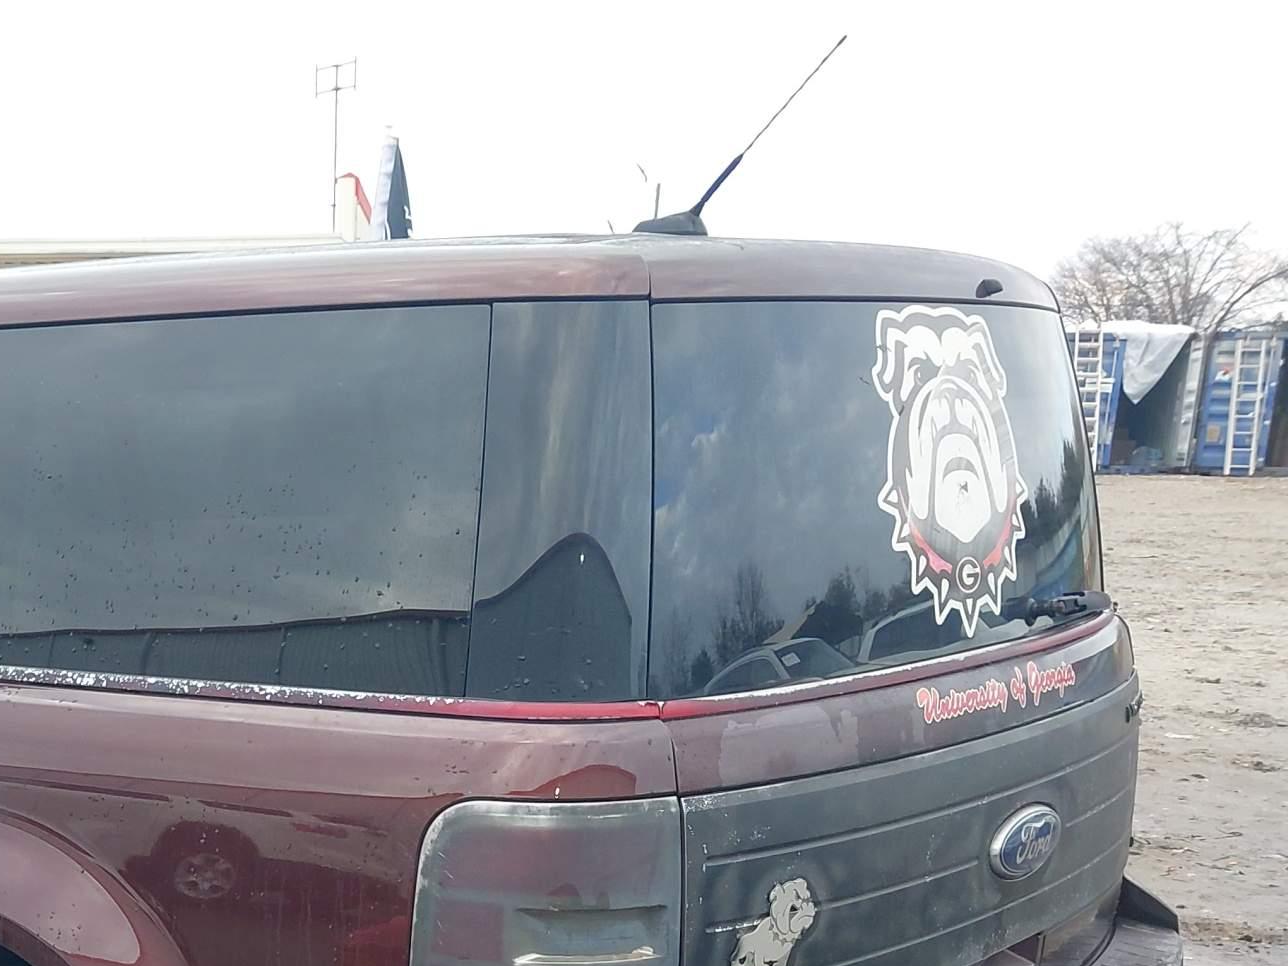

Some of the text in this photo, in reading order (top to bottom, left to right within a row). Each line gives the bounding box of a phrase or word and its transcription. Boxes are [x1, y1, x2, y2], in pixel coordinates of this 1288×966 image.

[957, 557, 981, 593] G
[916, 660, 1076, 724] University of Georgia
[1016, 815, 1056, 865] Ford
